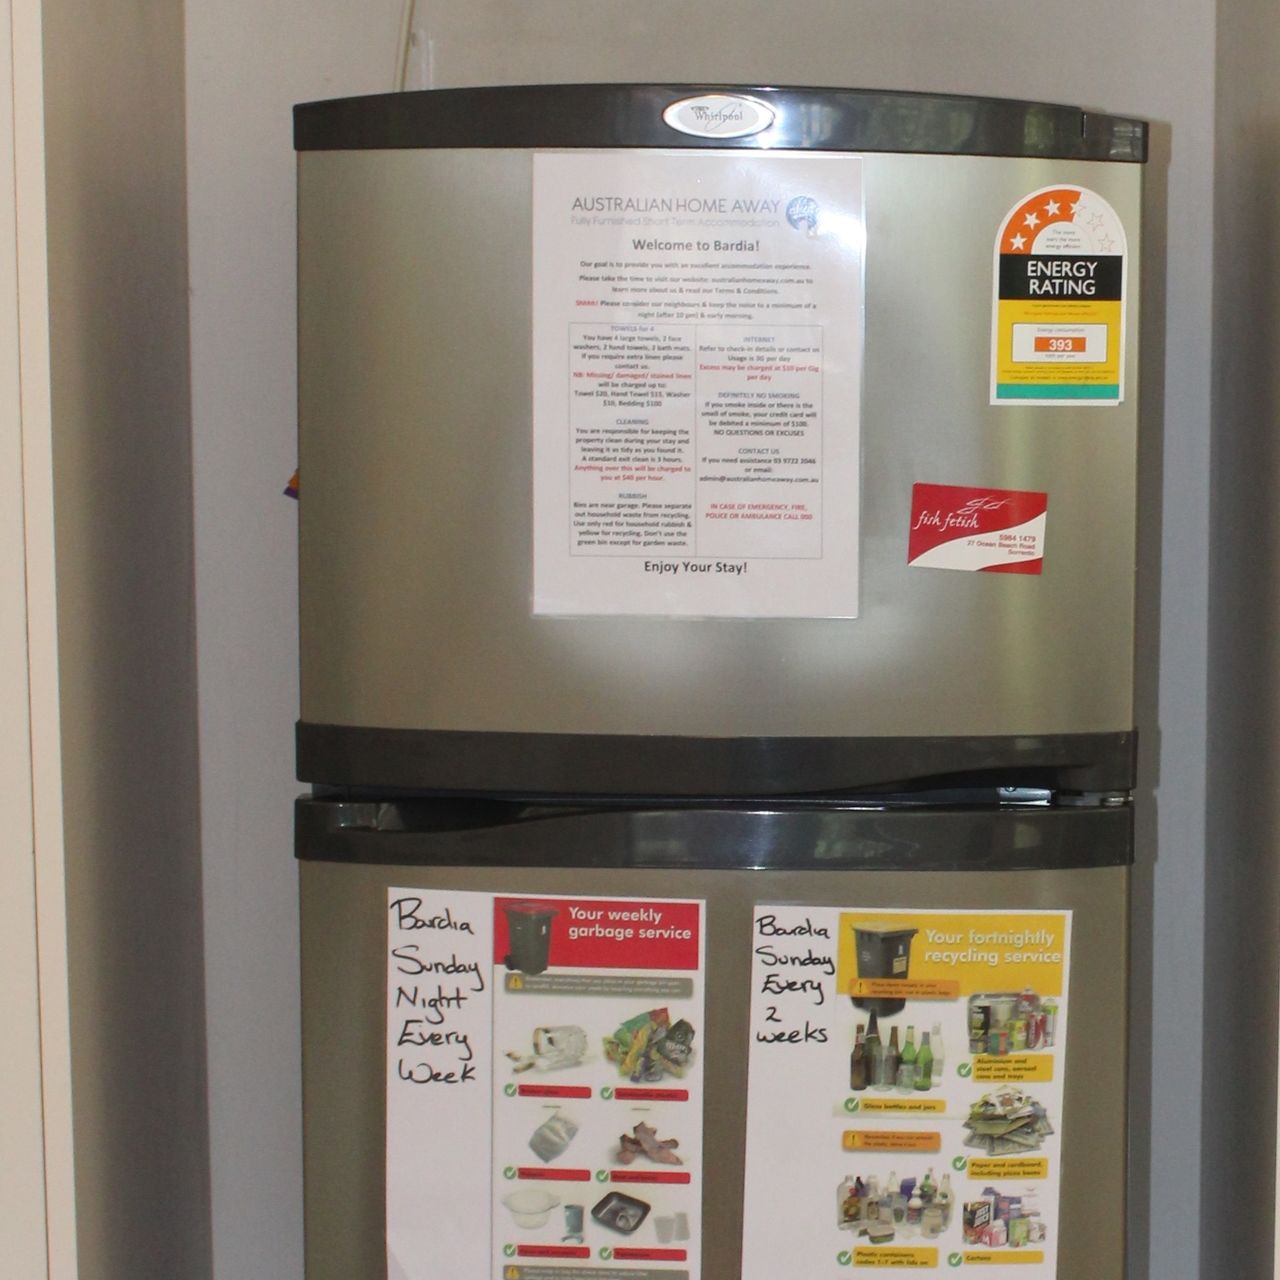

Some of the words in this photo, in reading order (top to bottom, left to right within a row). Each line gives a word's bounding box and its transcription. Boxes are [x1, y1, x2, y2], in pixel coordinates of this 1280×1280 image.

[572, 197, 672, 212] AUSTRALIAN
[676, 198, 726, 213] HOME
[731, 199, 780, 213] AWAY
[632, 239, 693, 251] Welcome
[697, 241, 710, 251] to
[714, 240, 760, 252] Bardia!
[1027, 260, 1098, 277] ENERGY
[1029, 279, 1096, 295] RATING
[1049, 339, 1072, 351] 393
[912, 510, 941, 530] fish
[939, 513, 980, 532] fetish
[644, 561, 678, 575] Enjoy
[683, 561, 712, 573] Your
[716, 561, 747, 575] Stay!
[390, 897, 475, 935] Bardia
[568, 906, 603, 921] Your
[608, 908, 662, 925] weekly
[568, 924, 634, 941] garbage
[638, 925, 692, 940] service
[755, 914, 831, 940] Bardia
[925, 929, 963, 945] Your
[968, 929, 1055, 948] fortnightly
[755, 945, 836, 976] Sunday
[924, 949, 999, 966] recycling
[1004, 950, 1063, 963] service
[391, 944, 485, 992] Sunday
[761, 974, 825, 1006] Every
[396, 985, 468, 1025] Night
[765, 1006, 783, 1023] 2
[397, 1019, 473, 1061] Every
[756, 1020, 828, 1043] weeks
[398, 1058, 476, 1084] Week
